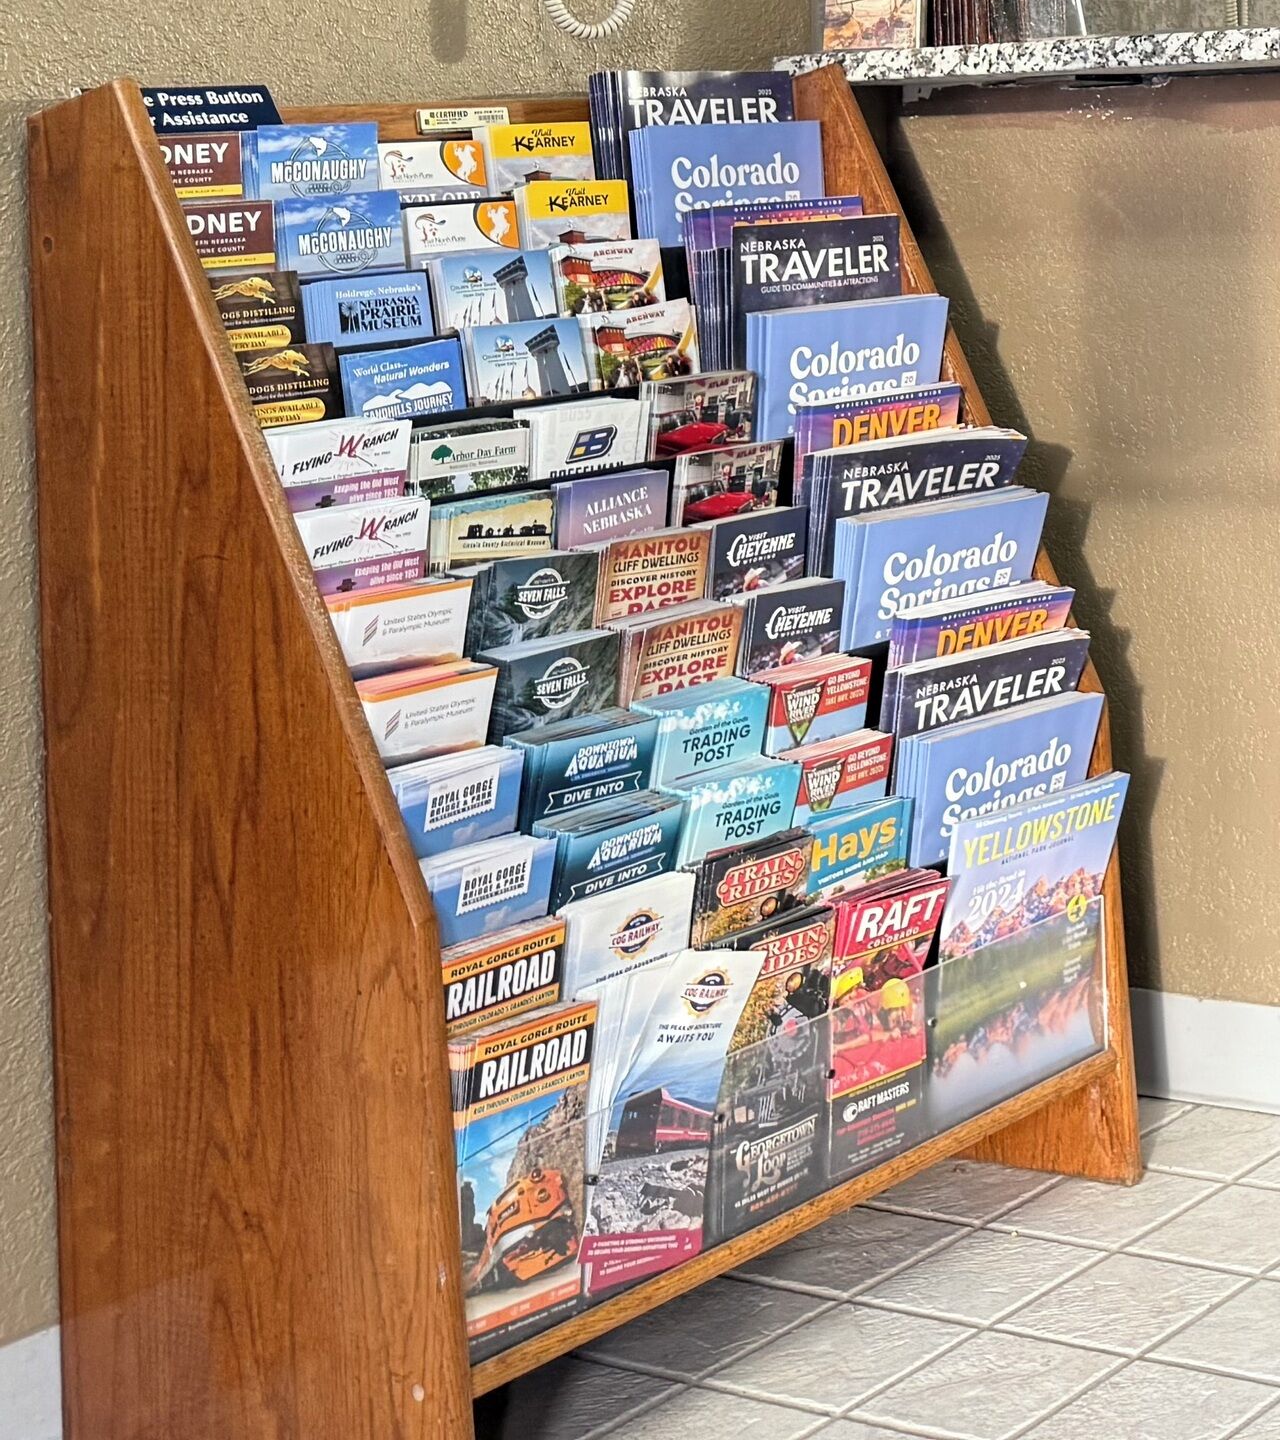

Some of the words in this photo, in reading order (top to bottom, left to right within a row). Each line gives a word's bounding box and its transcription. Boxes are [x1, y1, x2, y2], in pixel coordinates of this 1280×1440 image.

[160, 90, 203, 107] Press
[209, 91, 264, 105] Button
[163, 112, 249, 127] Assistance
[628, 97, 779, 128] TRAVELER
[512, 135, 575, 152] KEARNEY
[178, 168, 214, 176] NEBRASKA
[671, 152, 800, 189] Colorado
[547, 194, 609, 211] KEARNEY
[211, 237, 246, 245] NEBRASKA
[593, 248, 634, 257] ARCHWAY
[741, 238, 806, 252] NEBRASKA
[740, 244, 890, 285] TRAVELER
[359, 295, 419, 308] NEBRASKA
[378, 284, 422, 296] Nebraska's
[243, 306, 296, 318] DISTILLING
[360, 304, 420, 321] PRAIRIE
[360, 315, 422, 333] MUSEUM
[626, 310, 665, 325] ARCHWAY
[789, 334, 920, 380] Colorado
[277, 378, 329, 390] DISTILLING
[352, 365, 378, 378] World
[374, 367, 408, 385] Natural
[409, 361, 450, 378] Wonders
[413, 392, 453, 410] JOURNEY
[292, 451, 333, 475] FLYING
[362, 428, 399, 450] RANCH
[452, 450, 475, 462] Arbor
[477, 448, 493, 459] Day
[843, 462, 909, 481] NEBRASKA
[841, 462, 1000, 511] TRAVELER
[585, 487, 648, 517] ALLIANCE
[583, 503, 652, 537] NEBRASKA
[313, 535, 354, 560] FLYING
[383, 508, 419, 532] RANCH
[748, 532, 768, 540] VISIT
[613, 536, 701, 561] MANITOU
[727, 533, 796, 567] CHEYENNE
[883, 532, 1018, 586] Colorado
[613, 560, 639, 574] CLIFF
[642, 552, 700, 570] DWELLINGS
[611, 574, 658, 587] DISCOVER
[660, 568, 697, 580] HISTORY
[519, 587, 543, 603] SEVEN
[544, 585, 567, 599] FALLS
[608, 578, 697, 603] EXPLORE
[788, 605, 806, 614] VISIT
[648, 613, 735, 643] MANITOU
[765, 606, 833, 639] CHEYENNE
[673, 629, 731, 652] DWELLINGS
[640, 654, 728, 686] EXPLORE
[643, 652, 690, 670] DISCOVER
[690, 645, 729, 659] HISTORY
[536, 680, 562, 696] SEVEN
[563, 672, 587, 690] FALLS
[915, 673, 978, 699] NEBRASKA
[787, 693, 820, 711] WIND
[914, 665, 1066, 731] TRAVELER
[578, 736, 635, 759] DOWNTOWN
[682, 724, 751, 754] TRADING
[565, 744, 638, 777] AQUARIUM
[694, 744, 734, 766] POST
[808, 772, 840, 789] WIND
[945, 736, 1072, 802] Colorado
[431, 789, 459, 808] ROYAL
[463, 778, 493, 798] GORGE
[563, 789, 592, 805] DIVE
[595, 781, 624, 797] INTO
[715, 800, 781, 828] TRADING
[601, 822, 660, 850] DOWNTOWN
[725, 820, 765, 841] POST
[963, 792, 1121, 870] YELLOWSTONE
[587, 828, 662, 870] AQUARIUM
[811, 817, 897, 873] Hays
[1031, 845, 1047, 855] PARK
[465, 873, 493, 891] ROYAL
[496, 862, 527, 881] GORGE
[585, 875, 614, 895] DIVE
[617, 864, 648, 883] INTO
[729, 852, 798, 885] TRAIN
[728, 869, 794, 902] RIDES
[968, 878, 1026, 922] 2024
[856, 887, 946, 944] RAFT
[611, 934, 627, 946] COG
[628, 922, 660, 941] RAILWAY
[867, 926, 920, 950] COLORADO
[450, 960, 485, 978] ROYAL
[486, 948, 522, 967] GORGE
[522, 934, 557, 953] ROUTE
[447, 949, 556, 1019] RAILROAD
[684, 987, 698, 998] COG
[484, 1040, 519, 1056] ROYAL
[520, 1025, 554, 1044] GORGE
[555, 1013, 588, 1032] ROUTE
[696, 1032, 715, 1041] YOU
[480, 1029, 587, 1099] RAILROAD
[858, 1095, 876, 1112] RAFT
[877, 1082, 909, 1105] MASTERS
